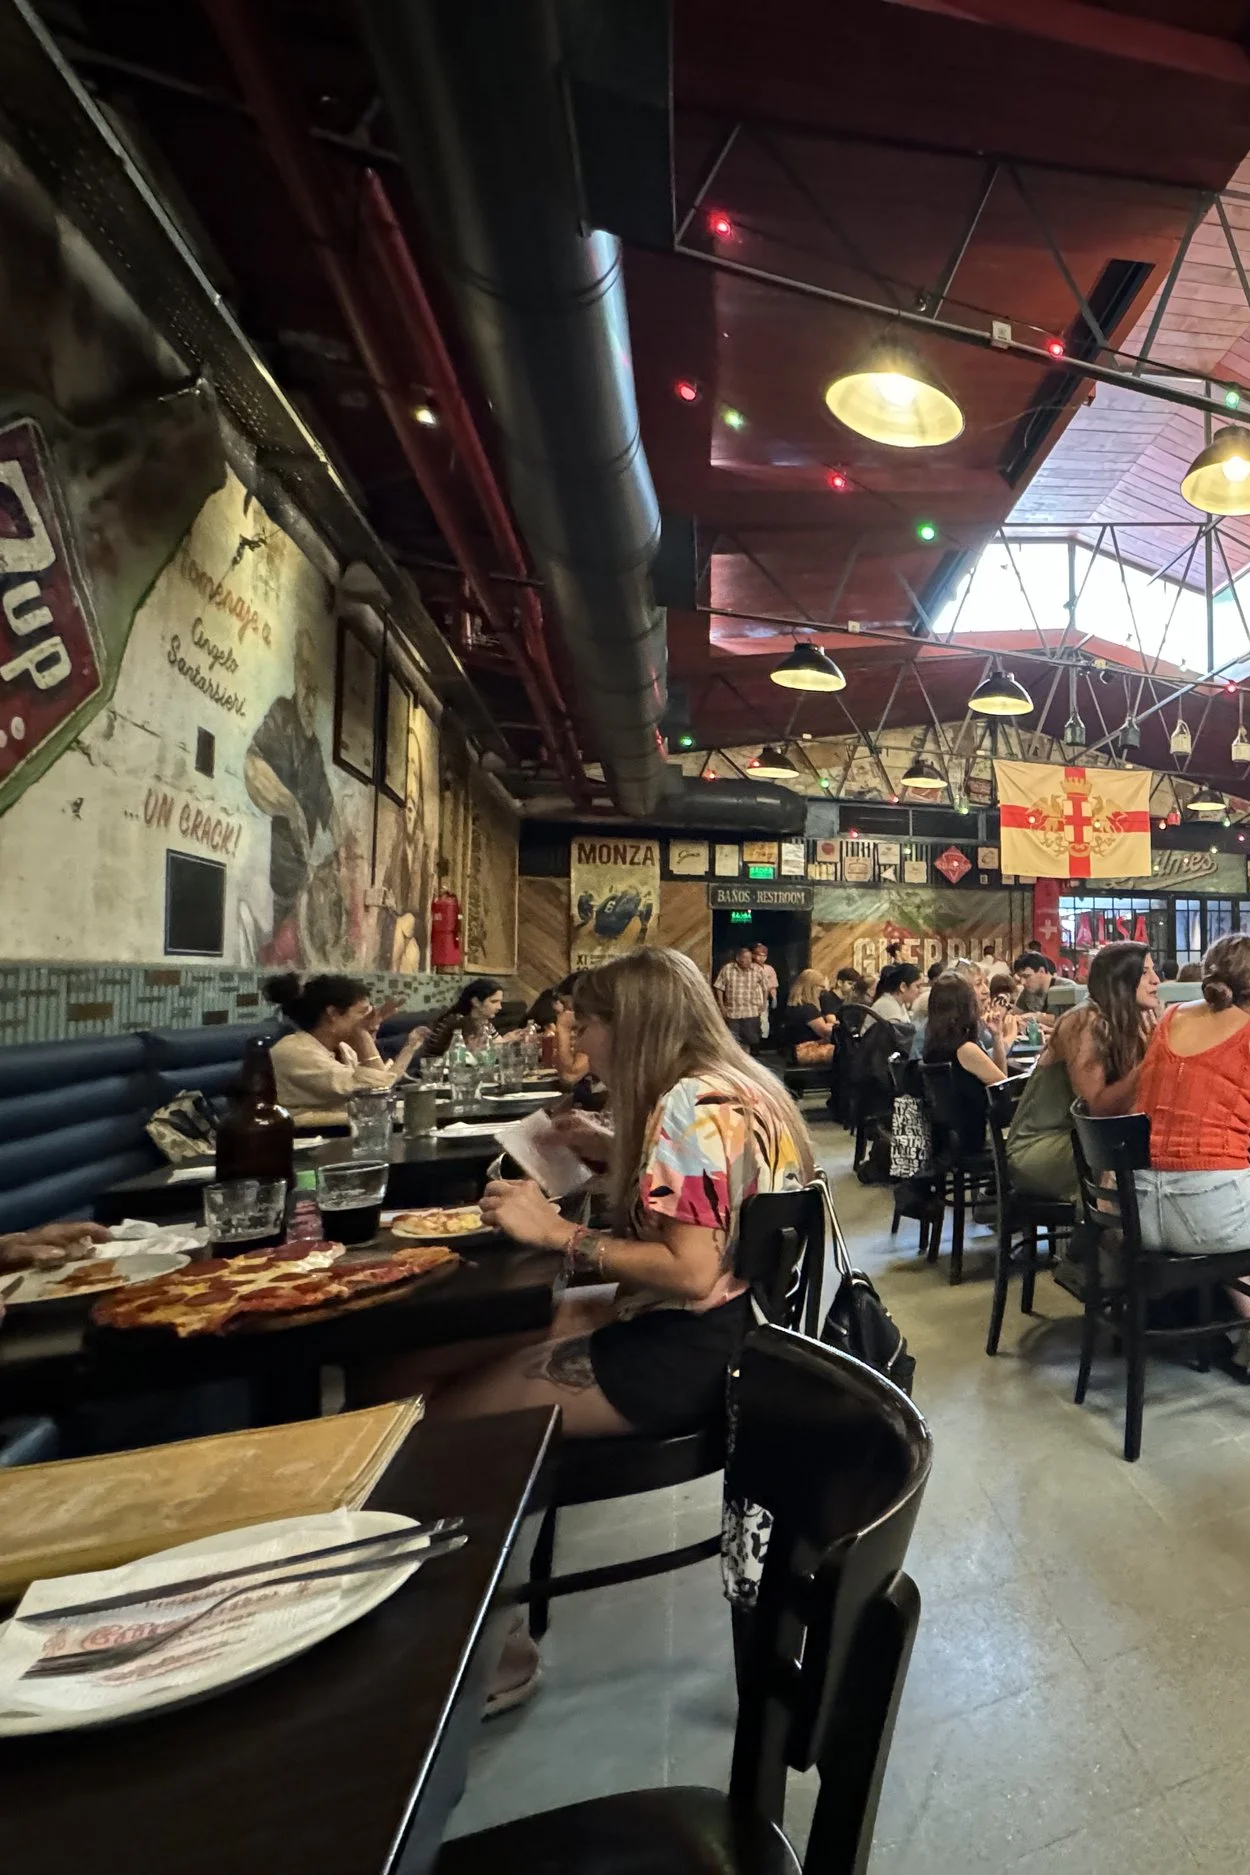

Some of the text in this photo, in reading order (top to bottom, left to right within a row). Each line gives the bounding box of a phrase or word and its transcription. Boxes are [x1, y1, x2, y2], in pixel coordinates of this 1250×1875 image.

[577, 843, 655, 866] MONZA
[718, 889, 805, 904] BAÑOS RESTROOM
[604, 900, 616, 913] 6
